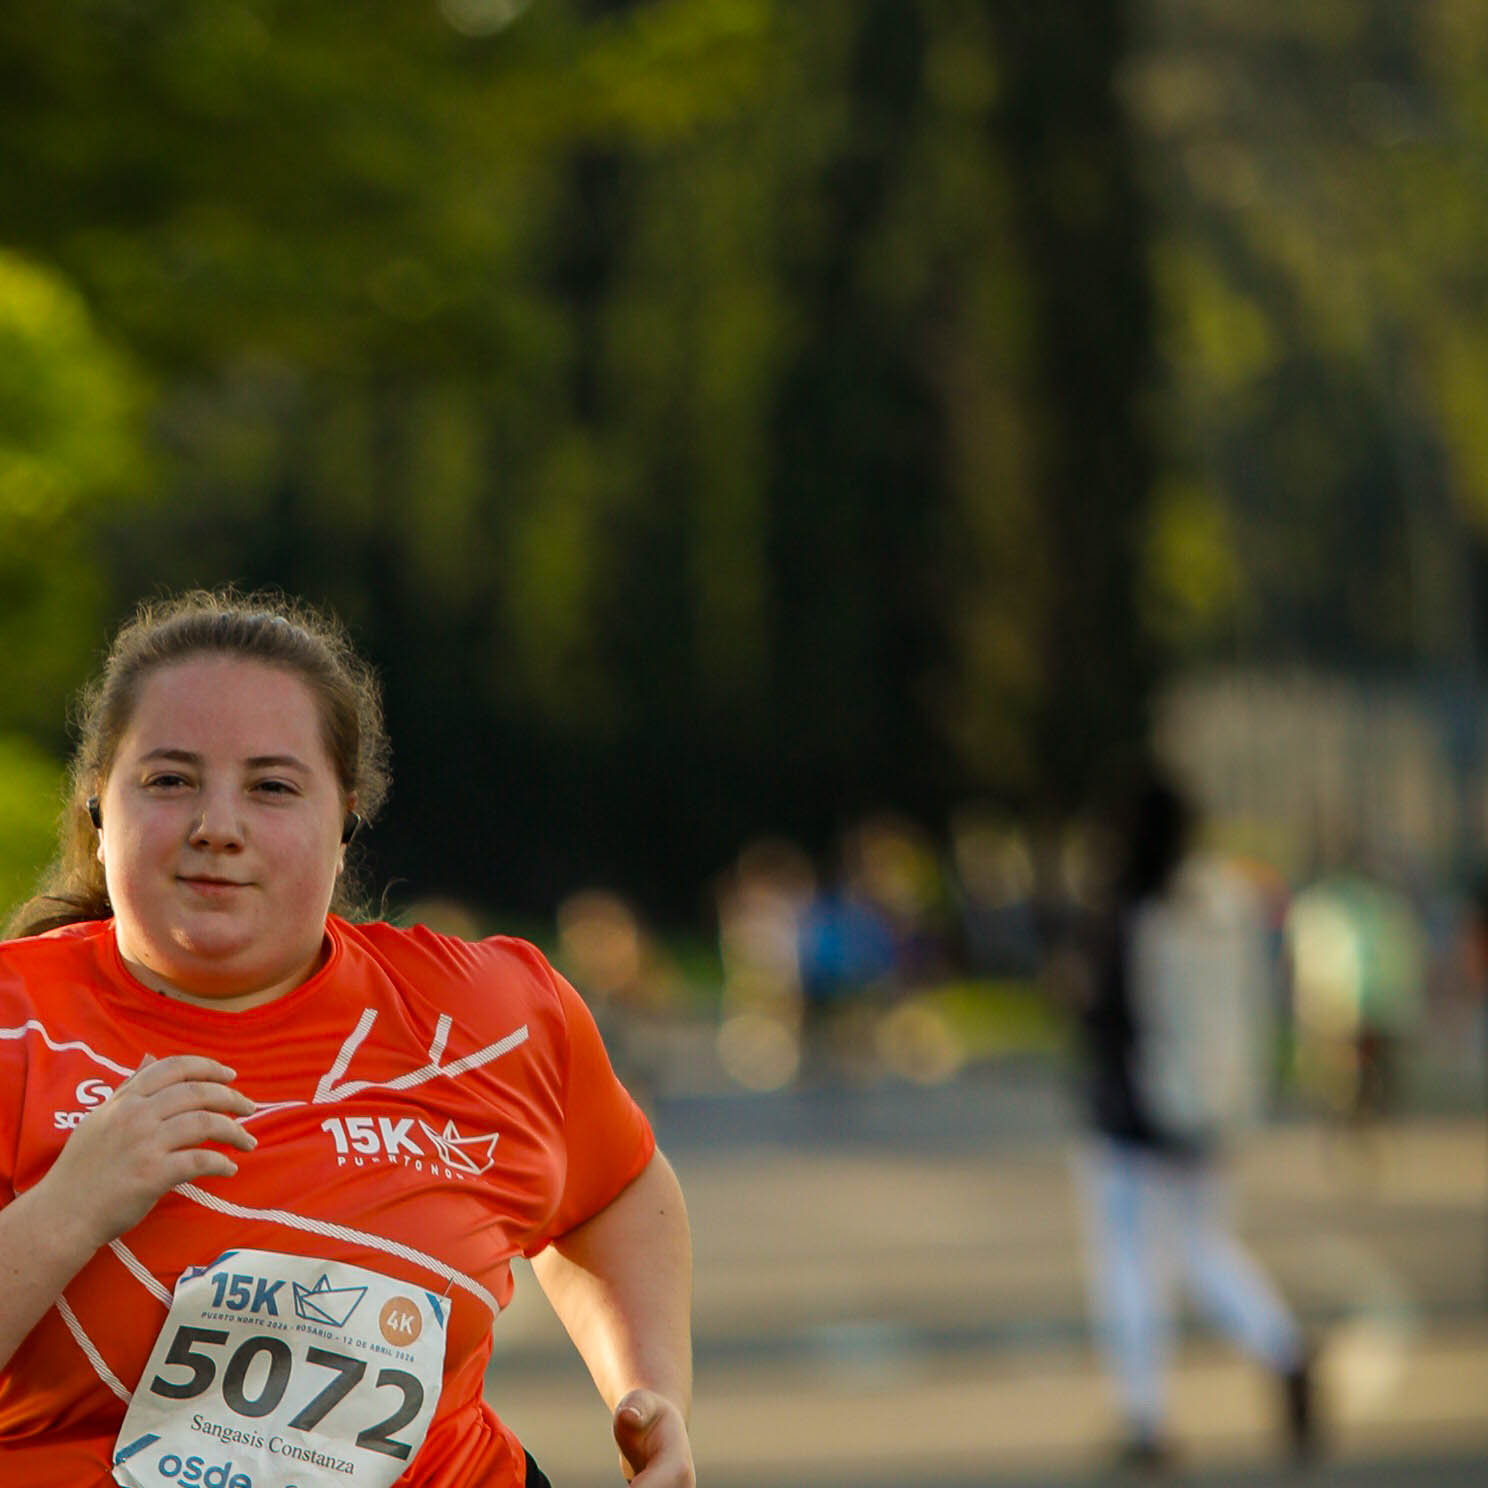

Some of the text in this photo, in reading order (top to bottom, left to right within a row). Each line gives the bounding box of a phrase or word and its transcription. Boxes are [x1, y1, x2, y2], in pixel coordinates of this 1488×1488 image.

[321, 1117, 424, 1156] 15K
[338, 1154, 423, 1171] PURTO
[211, 1271, 286, 1316] 15K
[201, 1311, 235, 1321] PUERTO
[237, 1315, 265, 1326] NORTE
[296, 1324, 333, 1339] ROSARIO
[343, 1336, 354, 1345] 12
[356, 1341, 368, 1349] DE
[370, 1344, 393, 1357] ABRIL
[387, 1311, 414, 1335] 4K
[150, 1325, 425, 1461] 5072
[190, 1414, 355, 1475] Sangasis Constanza
